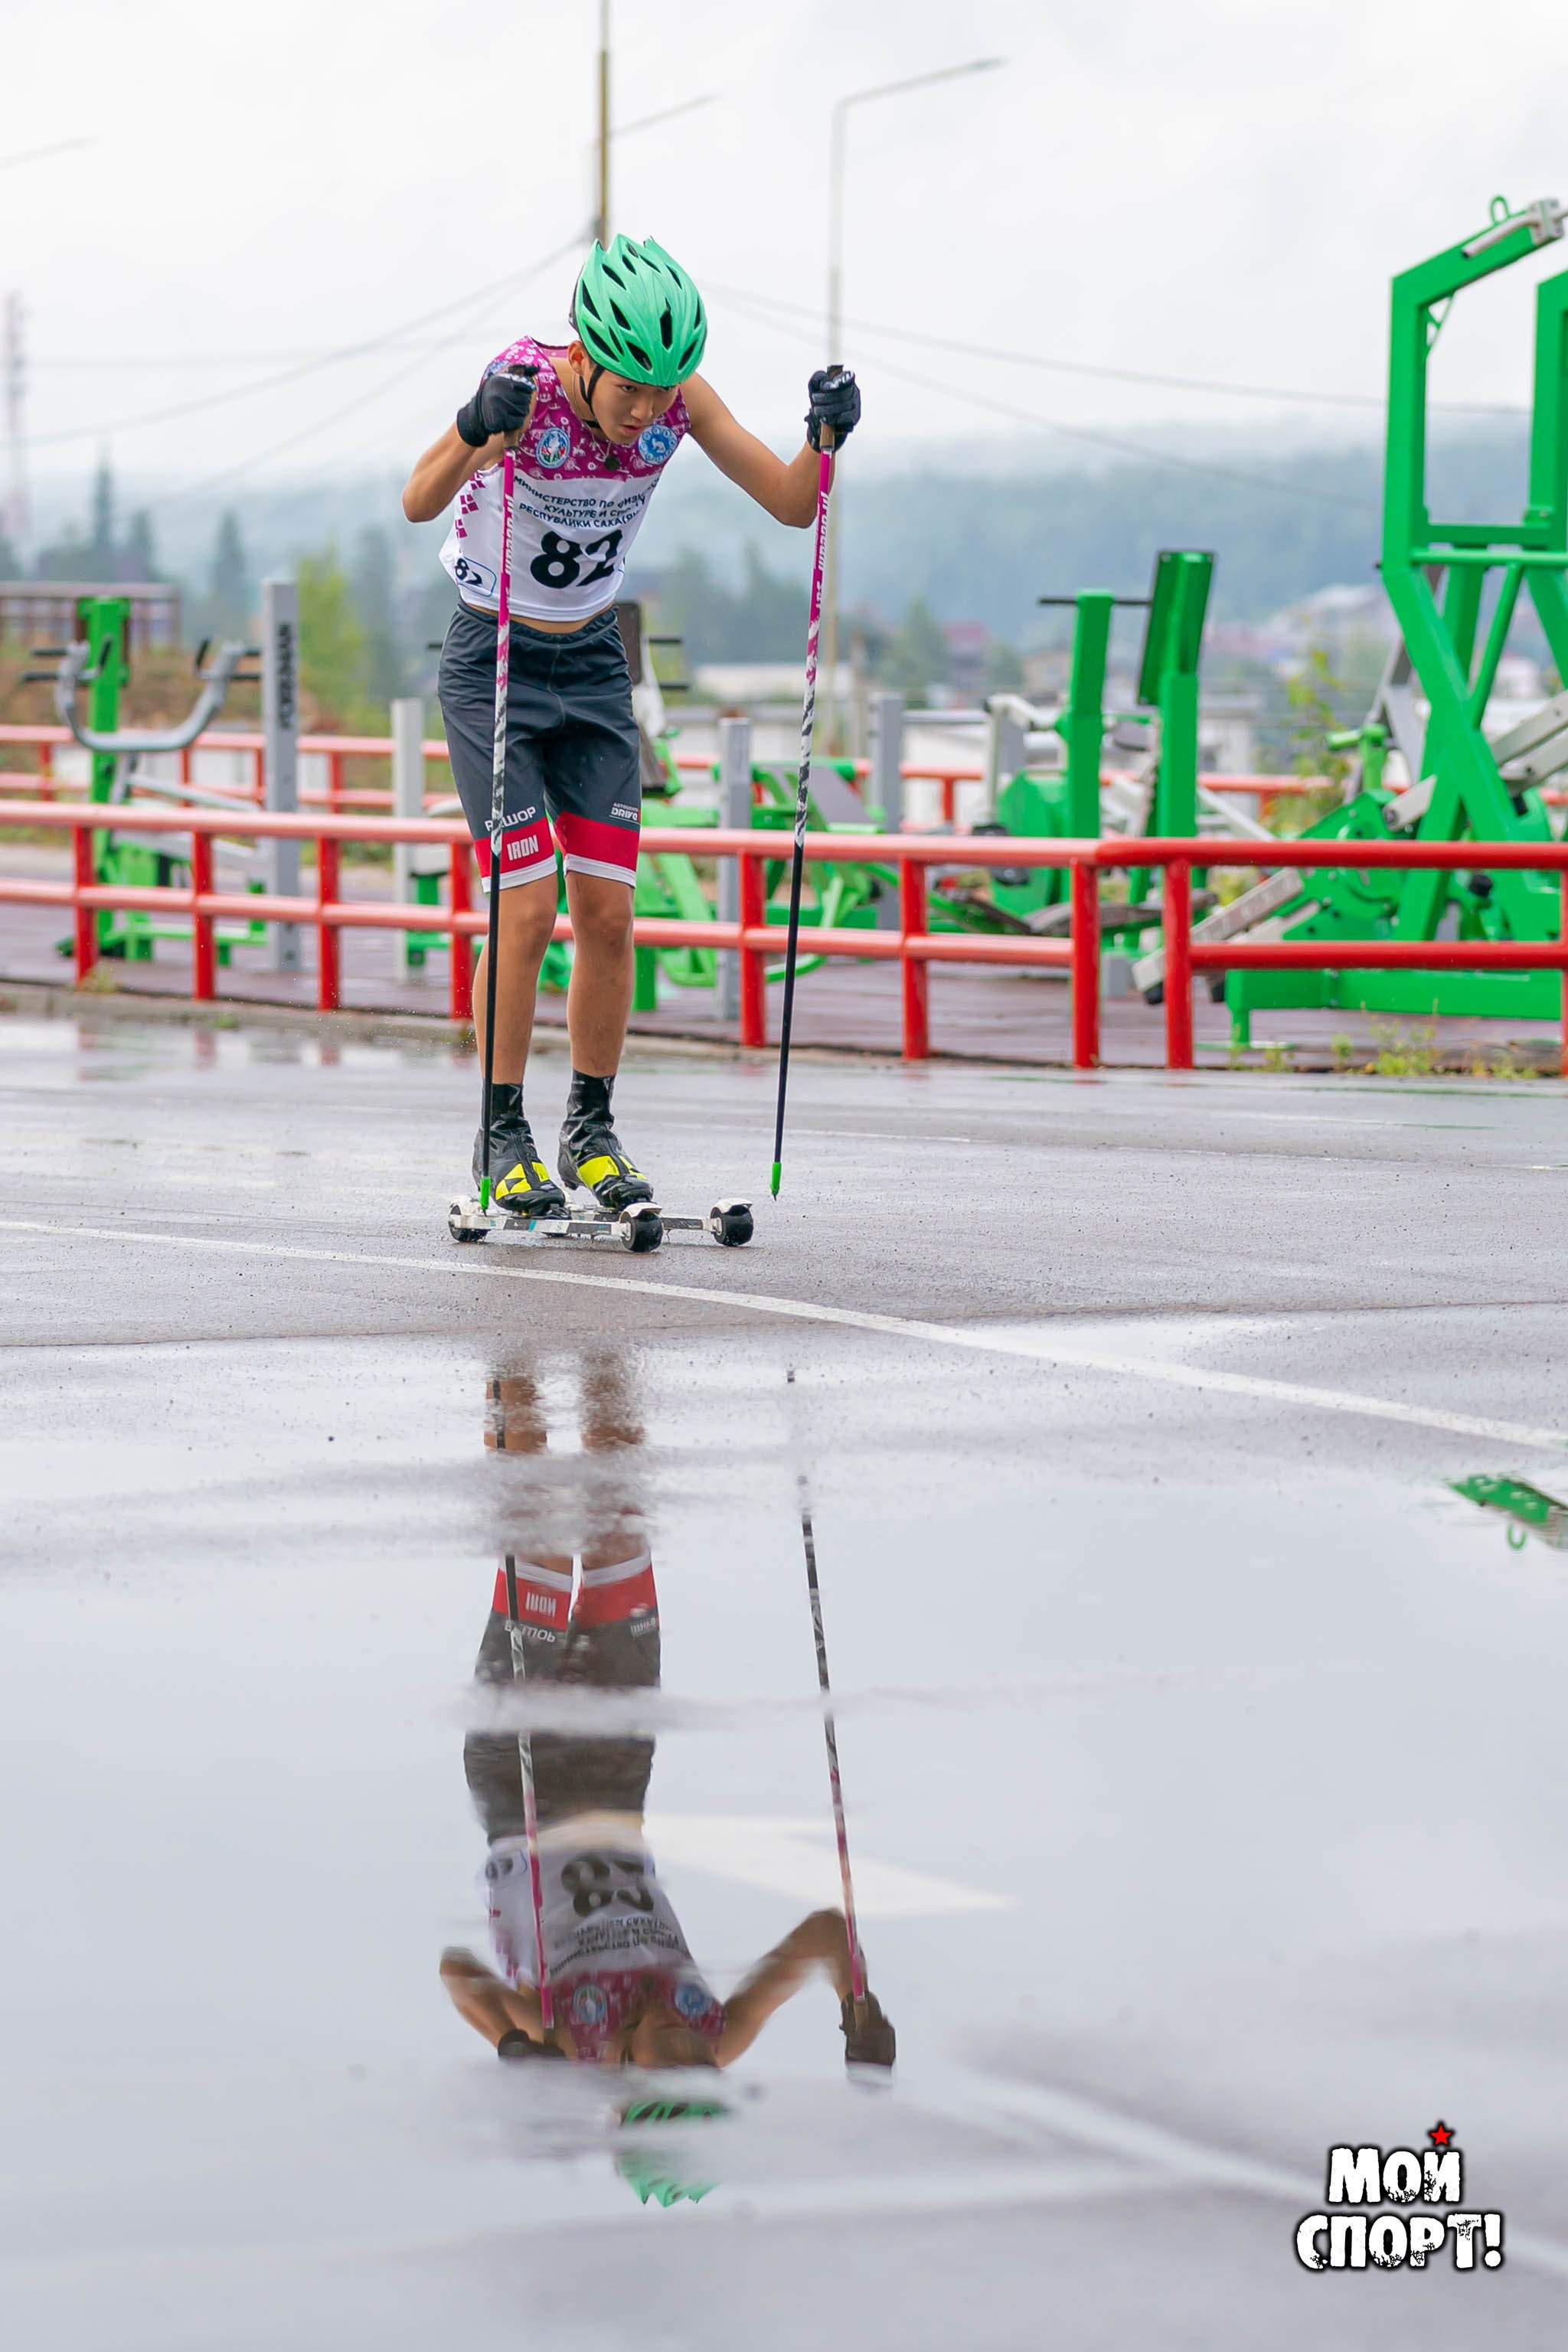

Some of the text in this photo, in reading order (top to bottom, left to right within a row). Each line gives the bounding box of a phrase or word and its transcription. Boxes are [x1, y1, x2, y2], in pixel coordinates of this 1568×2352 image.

[514, 475, 596, 507] МИНИСТЕРСТВО
[599, 499, 614, 508] ПО
[518, 502, 592, 528] РЕСПУБЛИКИ
[544, 504, 597, 519] КУЛЬТУРЕ
[530, 529, 623, 589] 82
[484, 806, 537, 832] РШОР
[506, 835, 539, 861] IRON
